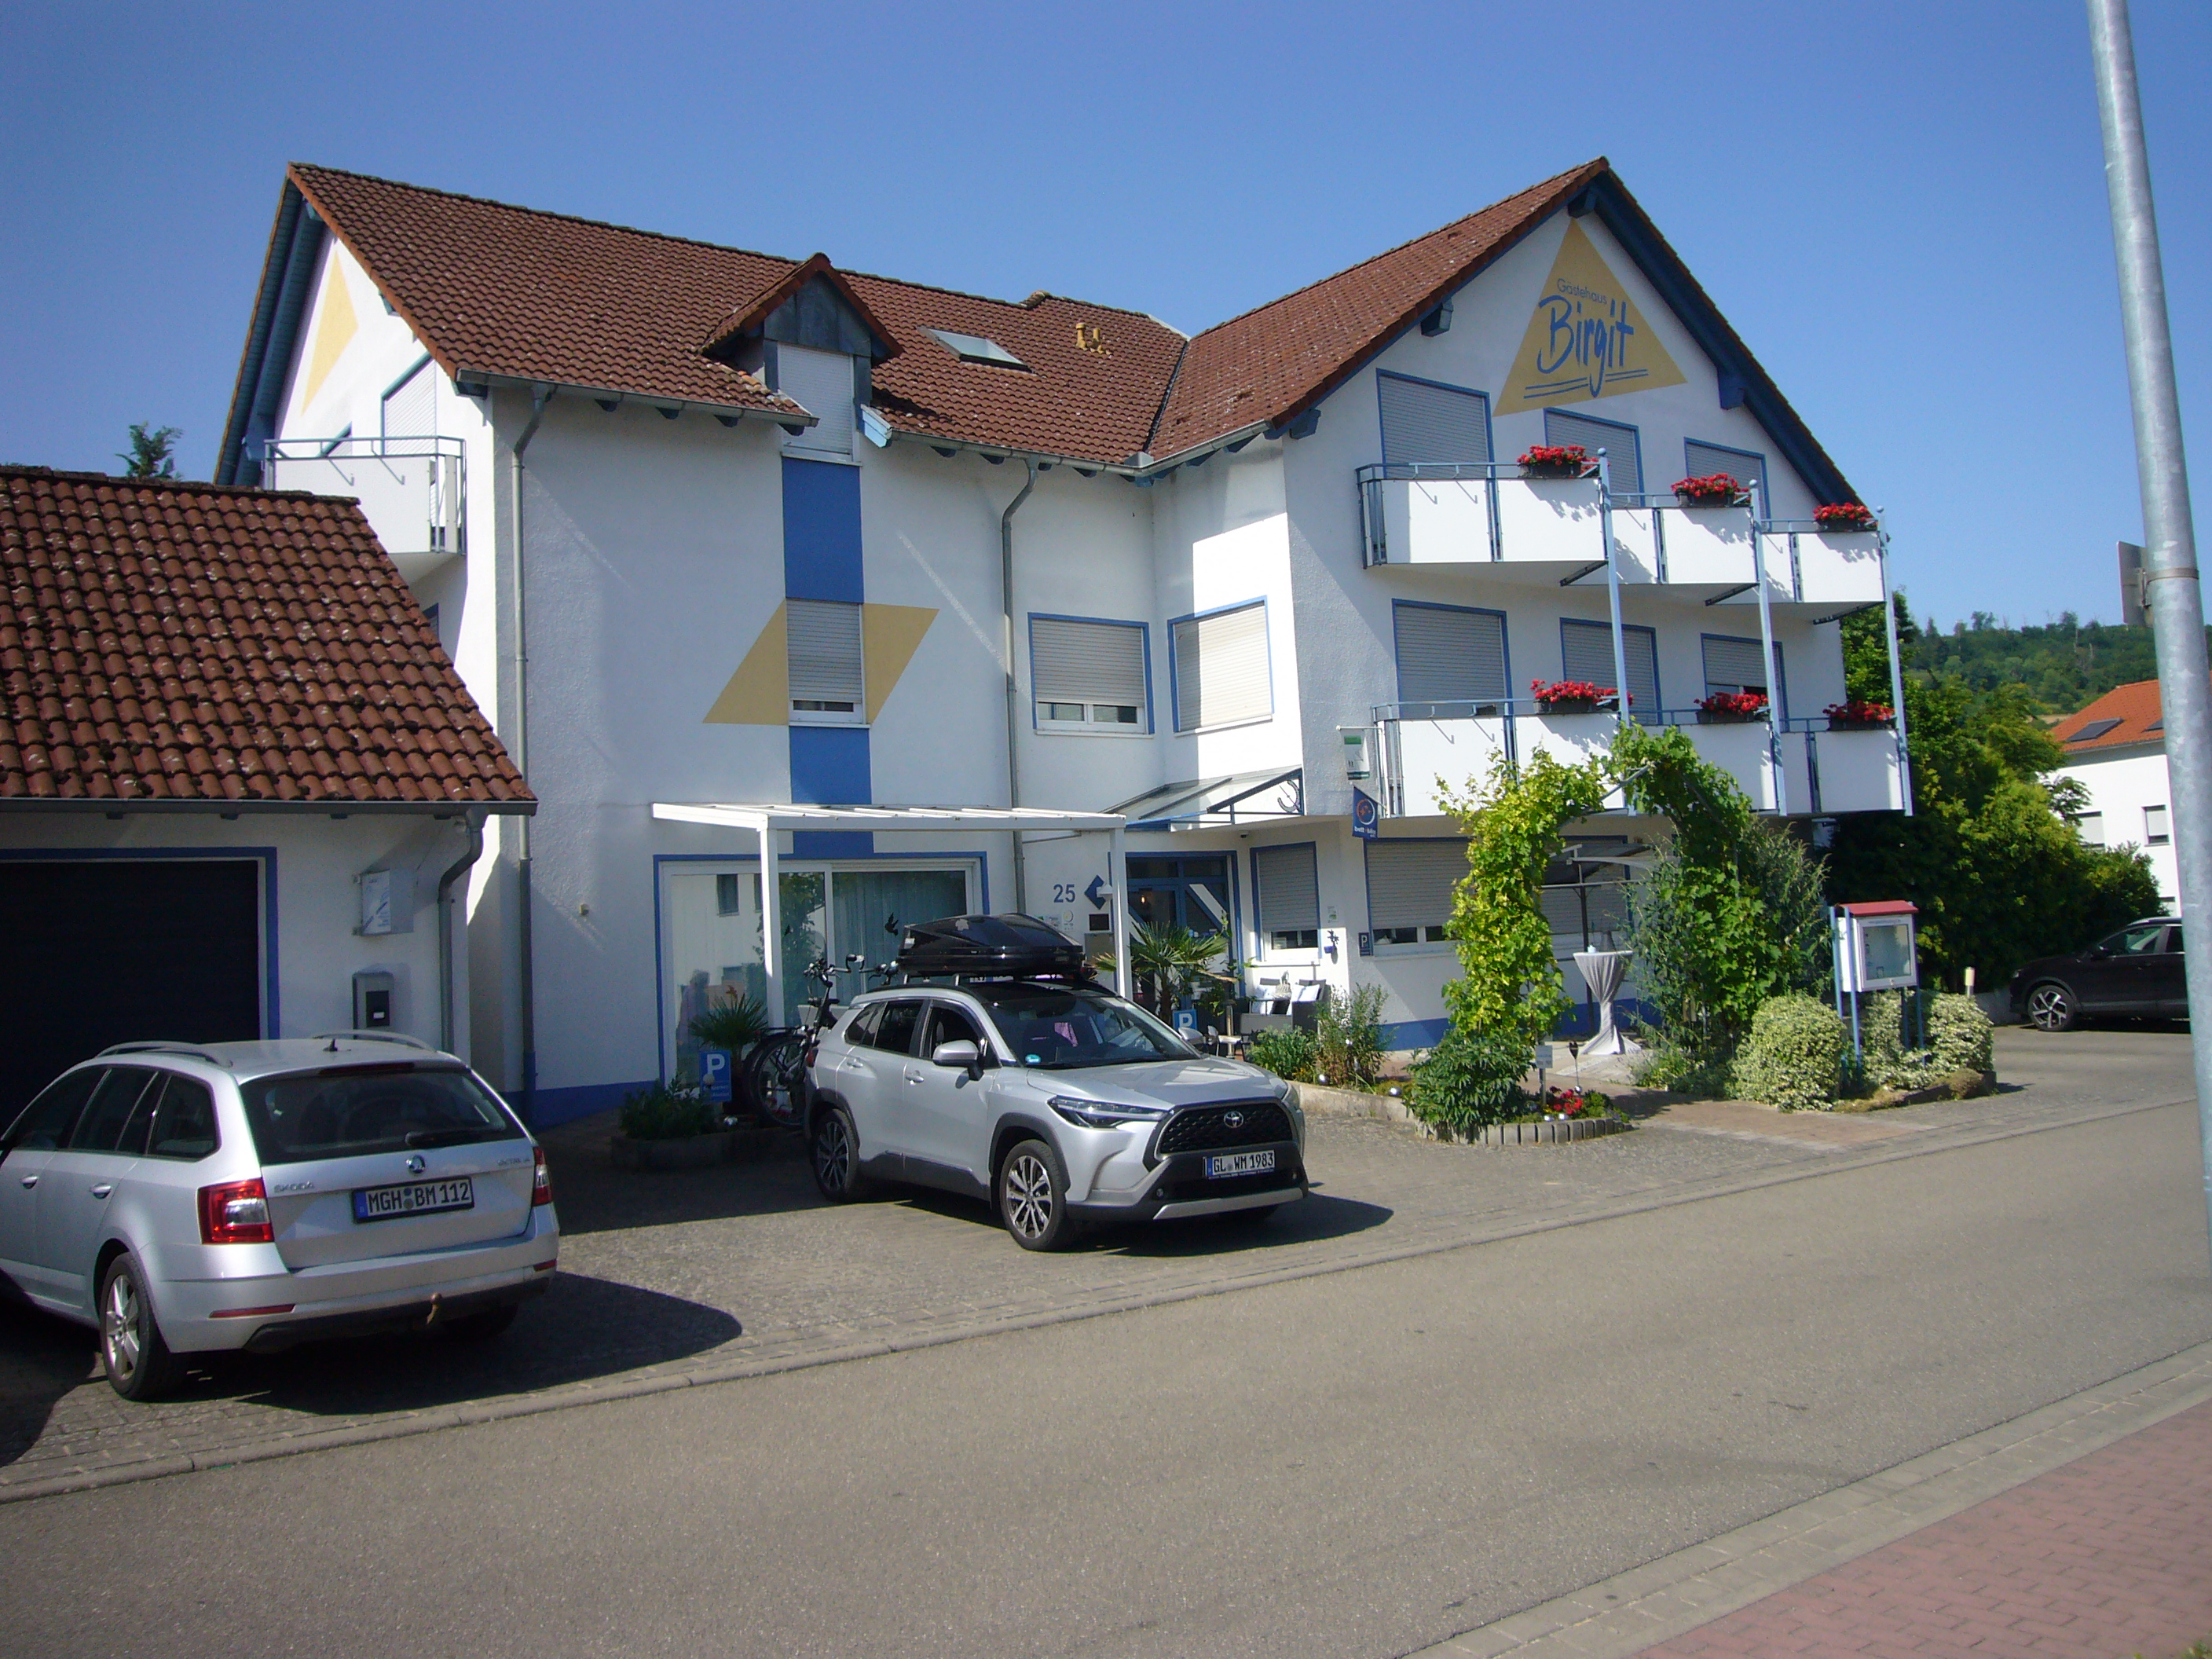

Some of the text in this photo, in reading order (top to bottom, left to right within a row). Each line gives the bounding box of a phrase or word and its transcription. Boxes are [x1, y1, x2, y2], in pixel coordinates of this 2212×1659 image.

[1557, 278, 1607, 305] Gästehaus
[1536, 295, 1635, 398] Birgit
[1053, 884, 1075, 903] 25
[1361, 935, 1368, 947] P
[707, 1053, 726, 1076] P
[1214, 1152, 1273, 1172] GL WM 1983
[368, 1182, 470, 1213] MGH BM 112
